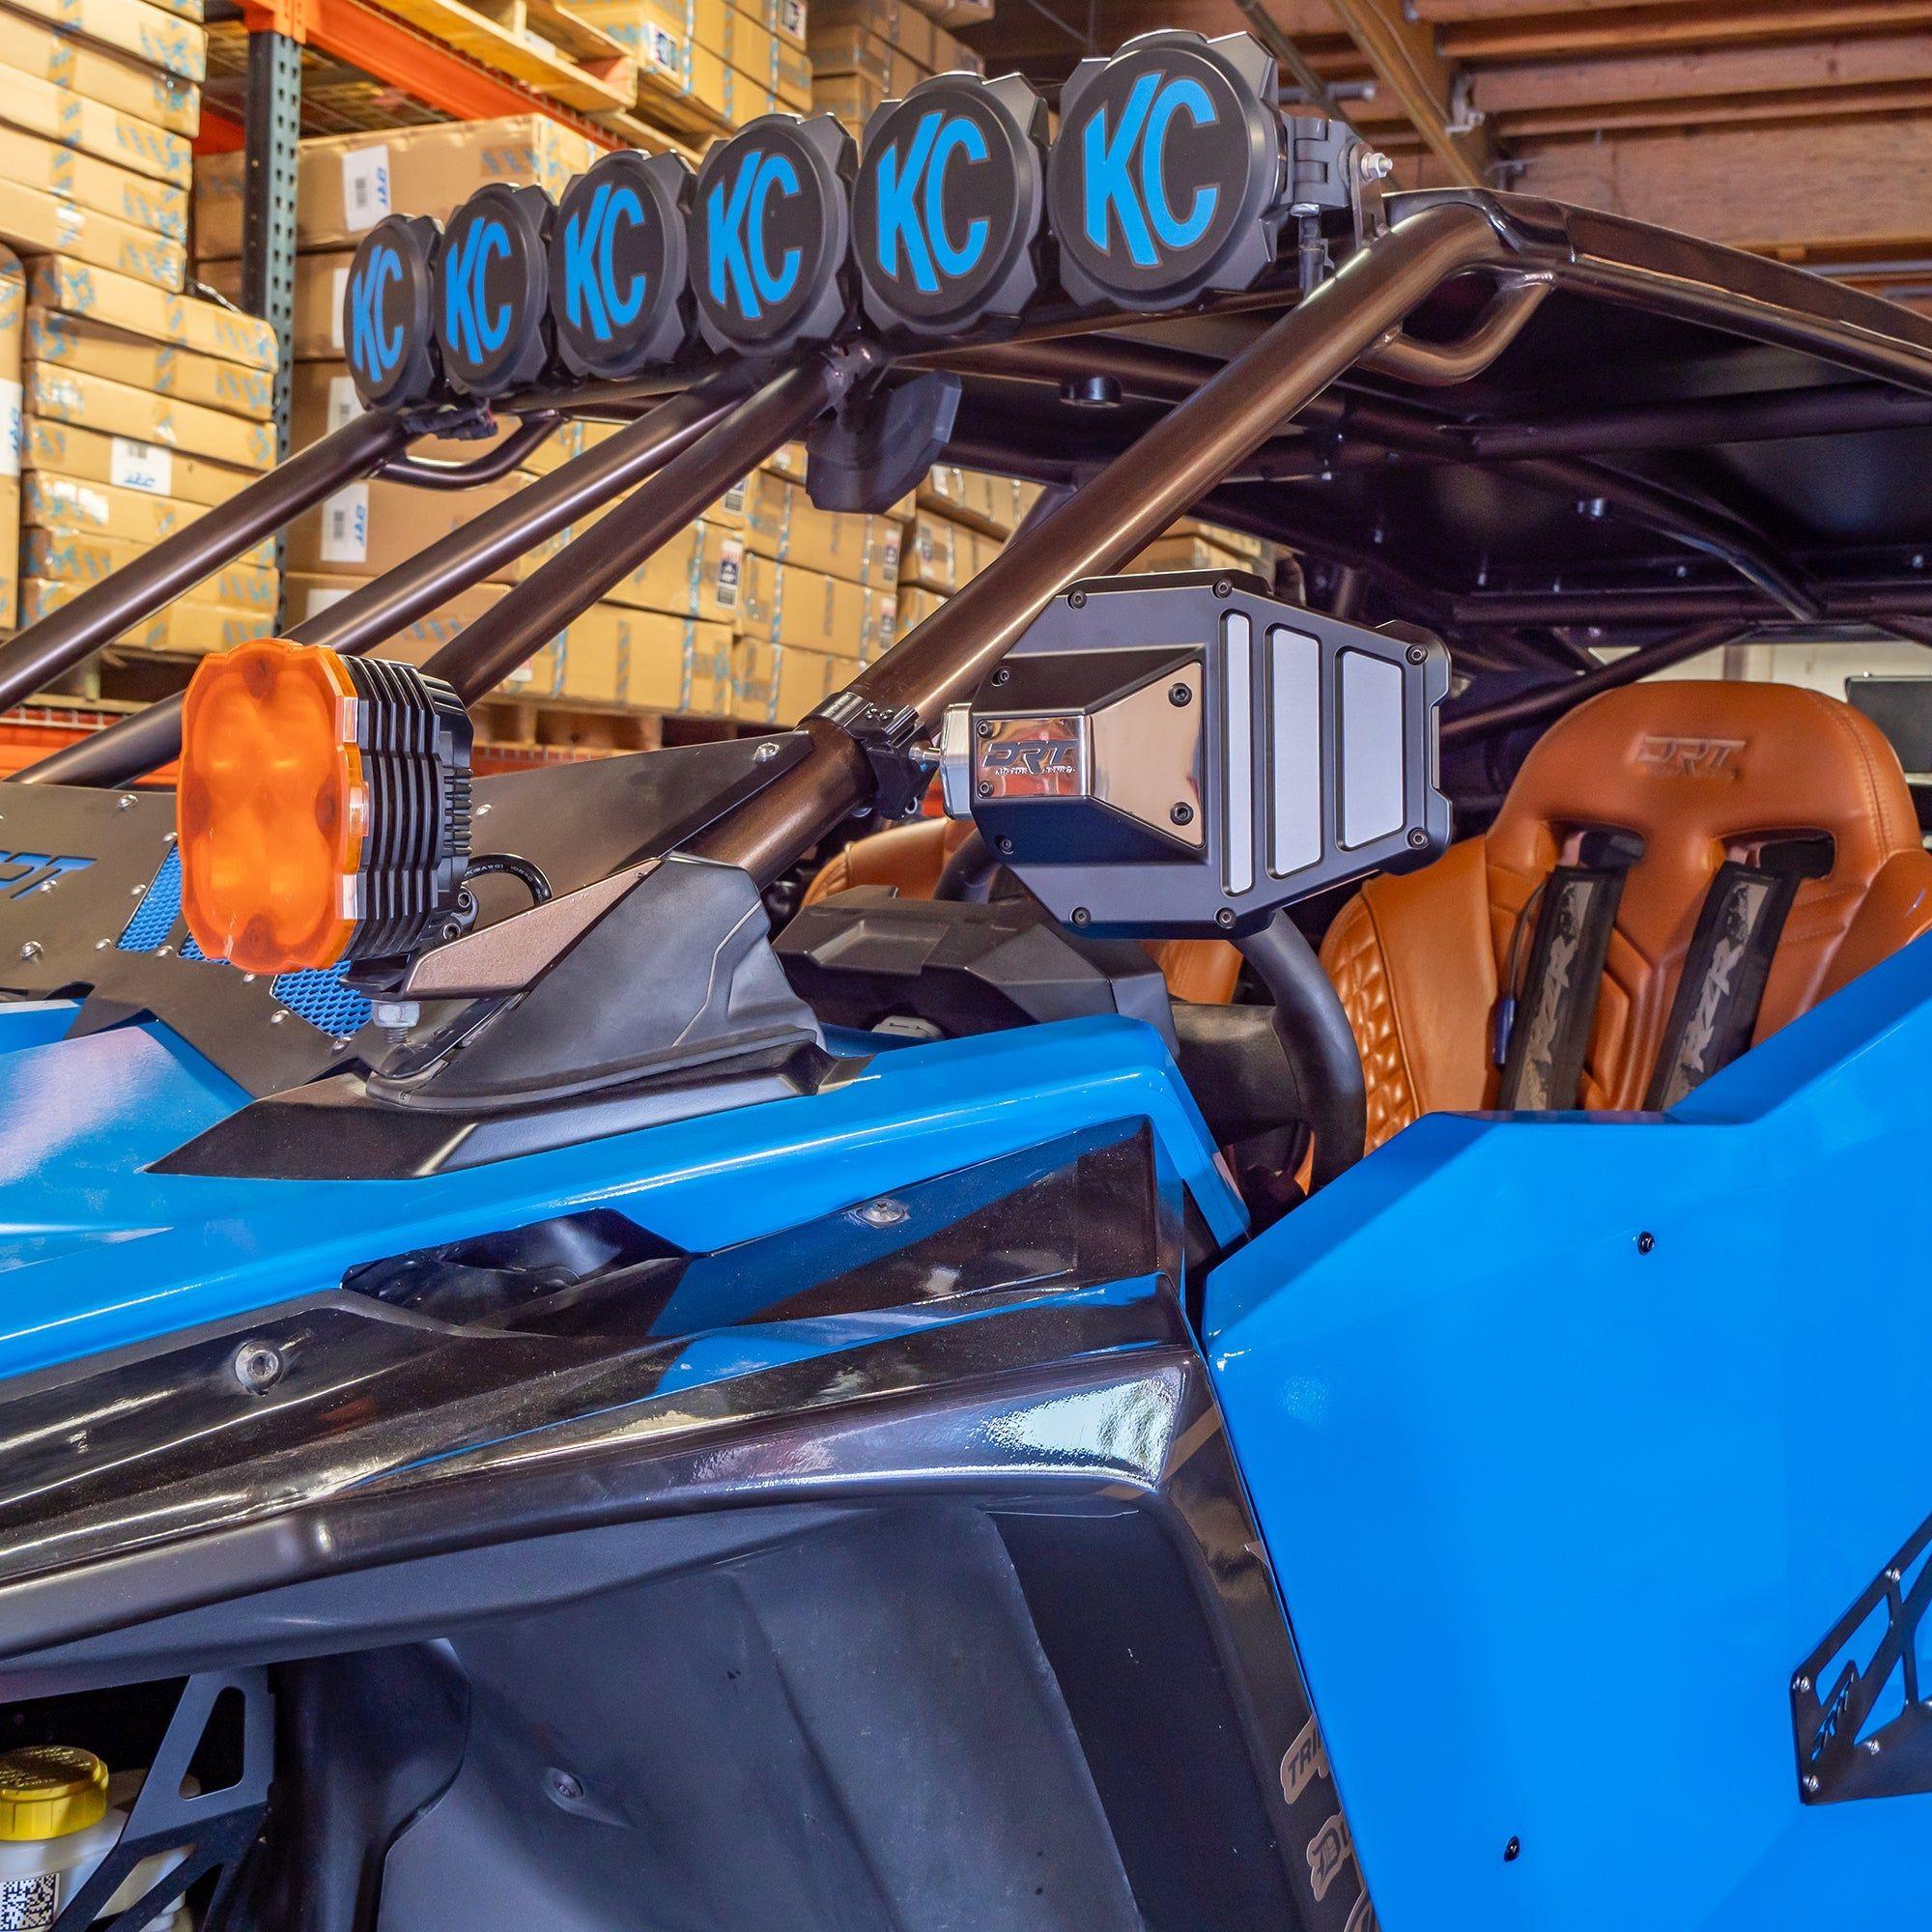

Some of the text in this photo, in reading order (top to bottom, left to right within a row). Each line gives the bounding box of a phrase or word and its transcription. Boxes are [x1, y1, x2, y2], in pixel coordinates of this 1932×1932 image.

[706, 150, 802, 320] KC
[876, 111, 990, 294] KC
[1083, 72, 1218, 267] KC
[352, 243, 404, 383] KC
[445, 217, 512, 365] KC
[564, 184, 647, 341] KC
[982, 739, 1079, 775] DRT
[1634, 734, 1747, 775] DRT
